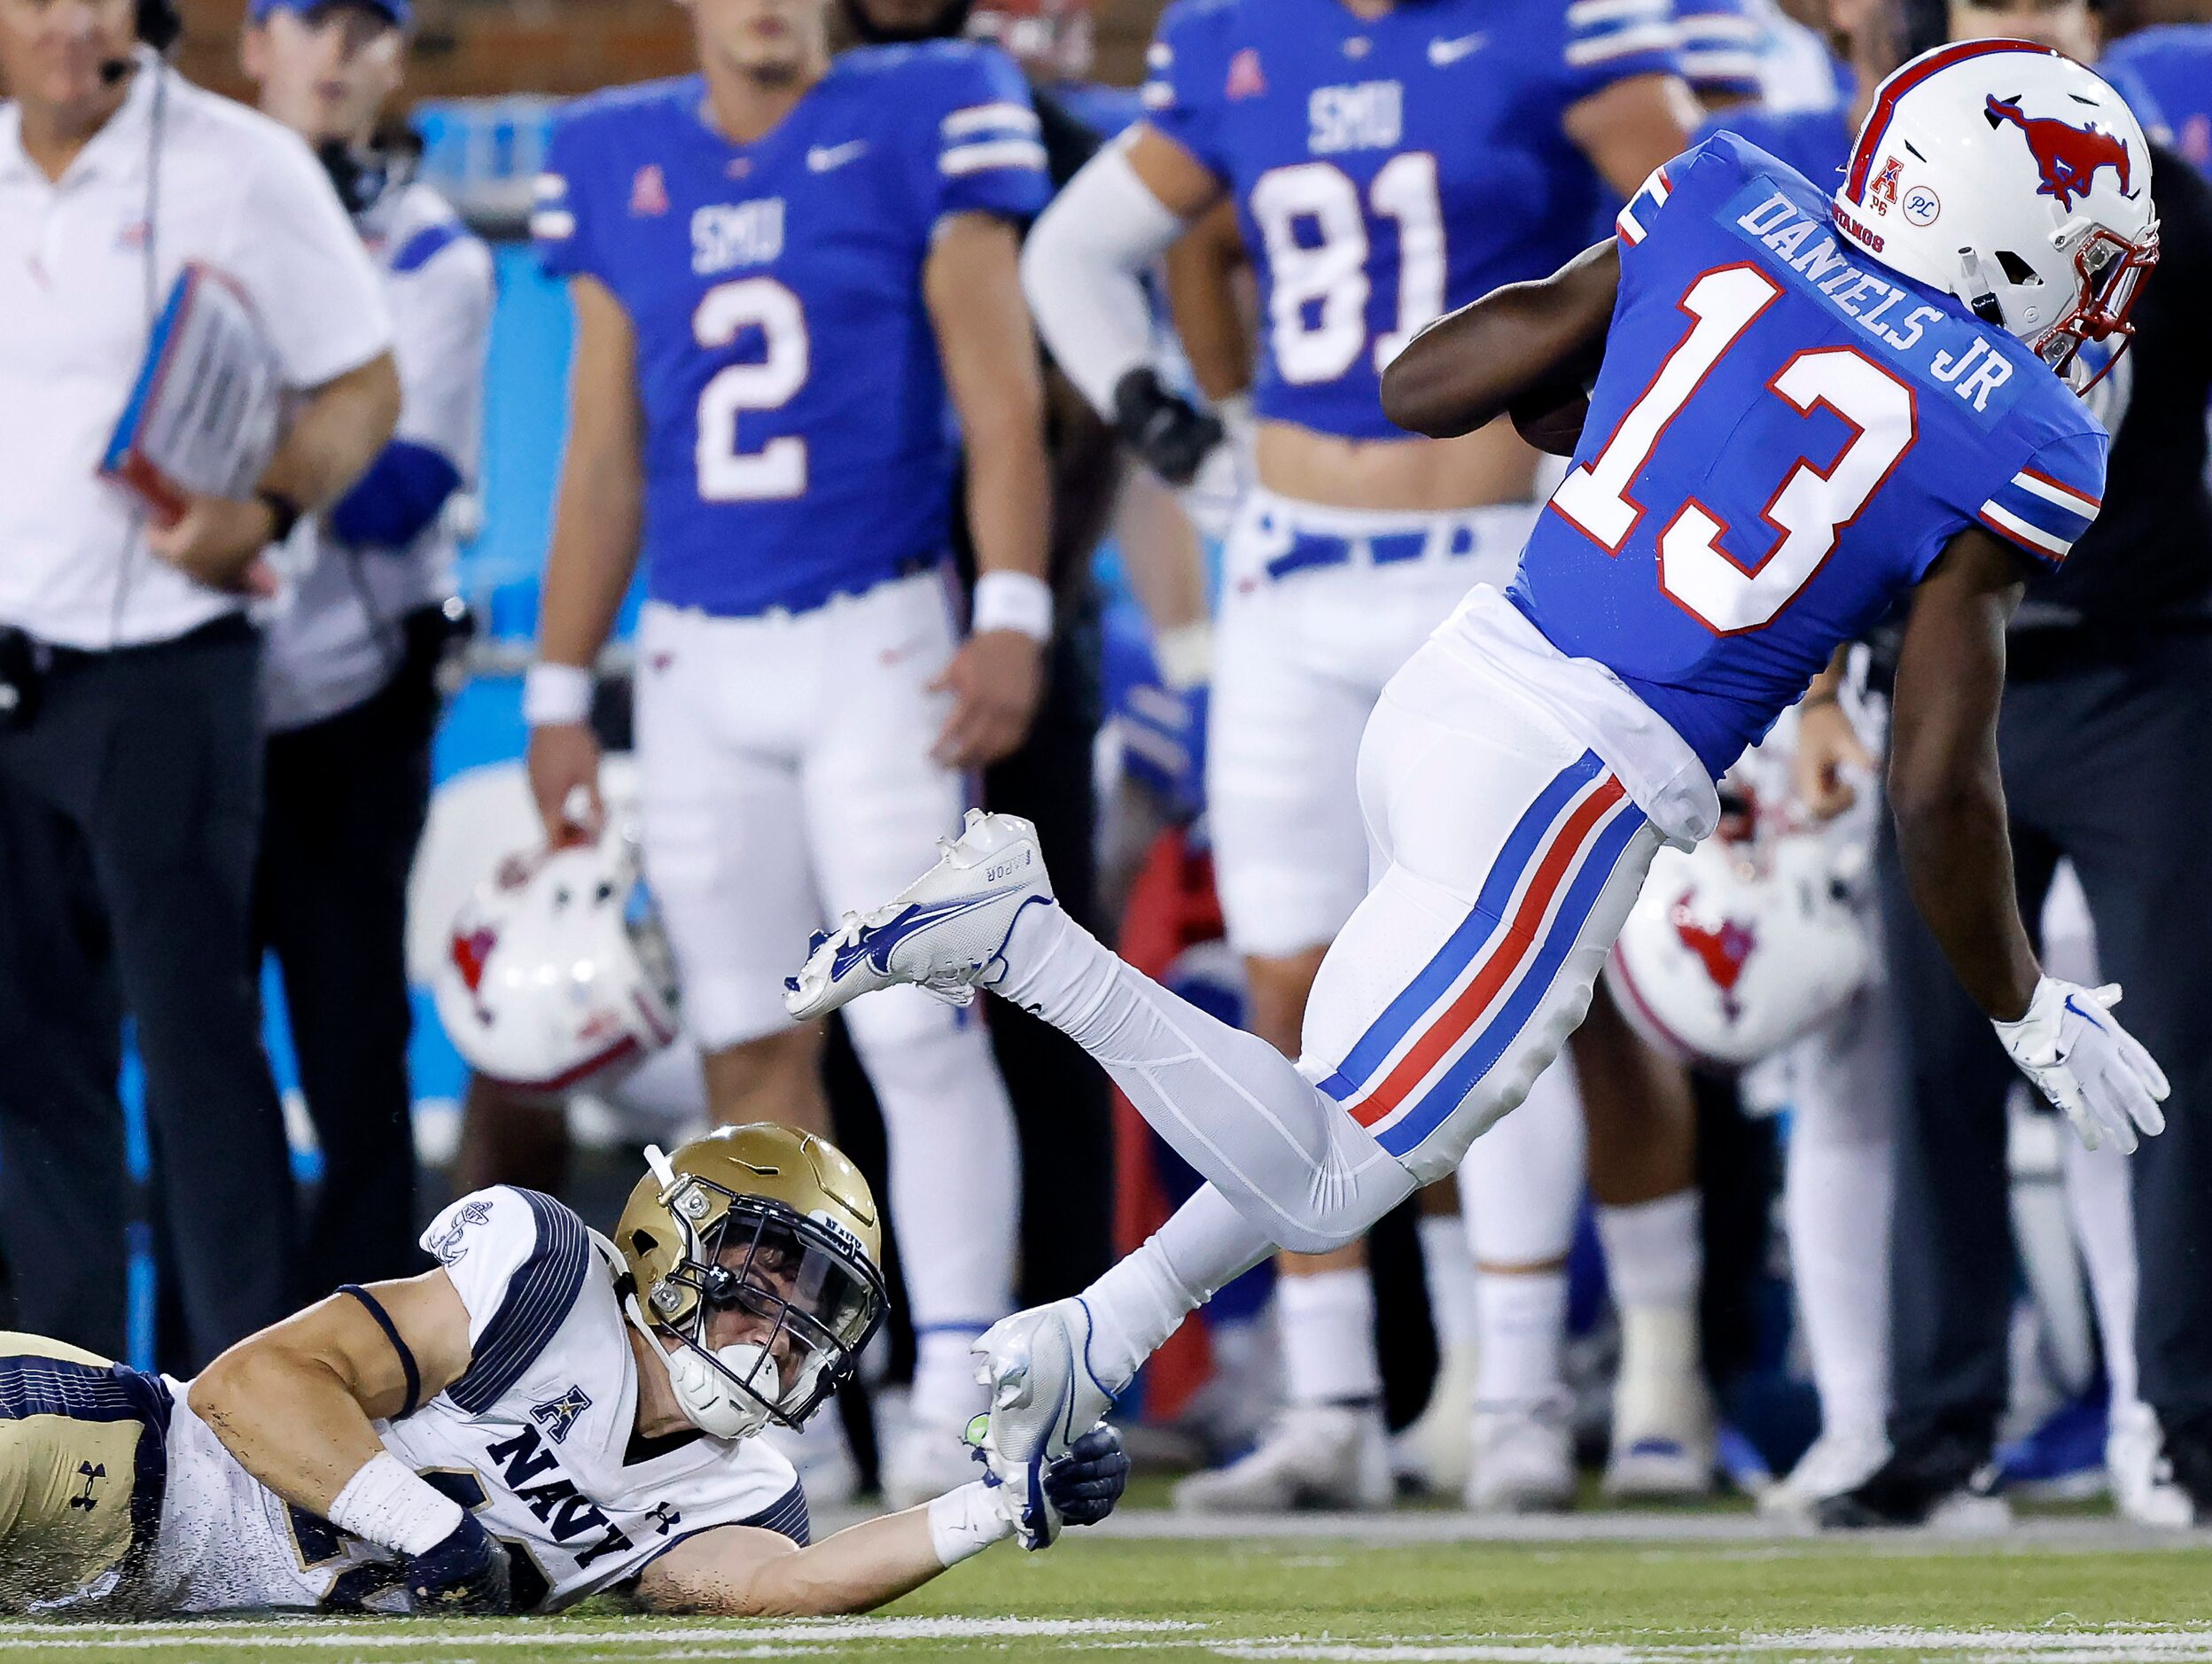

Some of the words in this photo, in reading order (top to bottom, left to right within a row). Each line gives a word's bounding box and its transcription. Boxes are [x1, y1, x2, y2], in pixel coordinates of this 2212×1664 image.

[1308, 79, 1403, 154] SMU
[690, 196, 787, 274] SMU
[1250, 152, 1446, 385] 81
[1831, 202, 1885, 253] TANGS
[1907, 196, 1935, 217] PL
[1736, 191, 1944, 350] DANIELS
[1929, 335, 2013, 413] JR
[691, 276, 810, 502] 2
[1547, 260, 1919, 637] 13
[486, 1423, 635, 1569] NAVY
